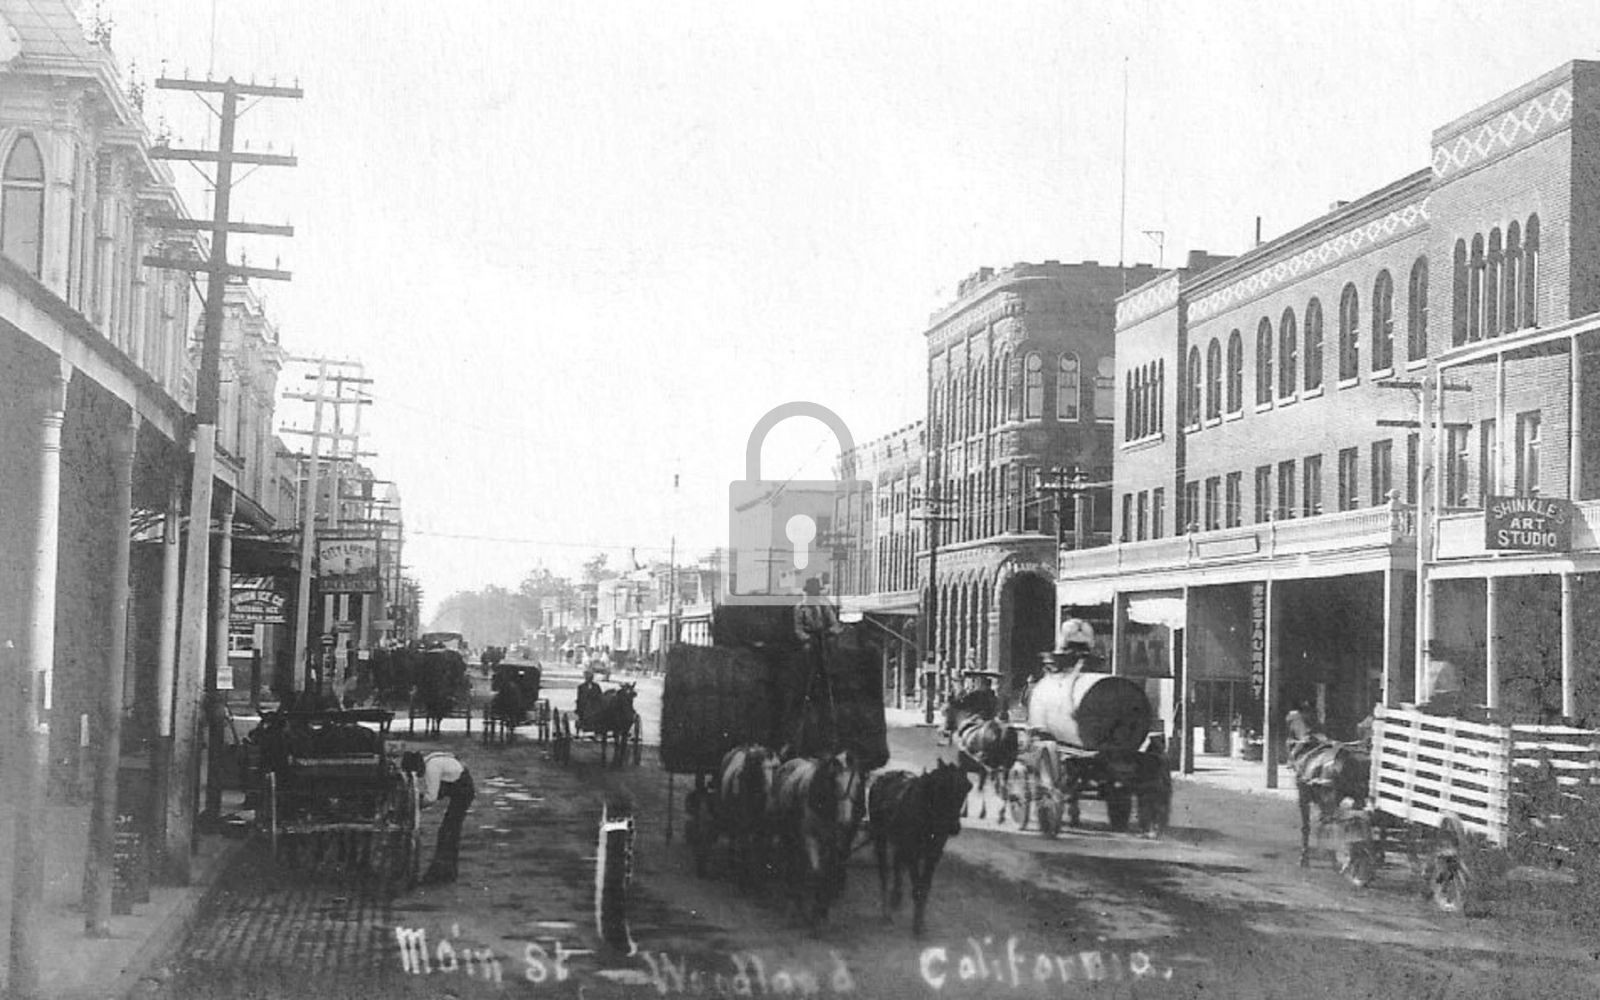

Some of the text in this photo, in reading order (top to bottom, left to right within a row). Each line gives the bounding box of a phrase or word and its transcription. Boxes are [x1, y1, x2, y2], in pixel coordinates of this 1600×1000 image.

[1493, 498, 1564, 523] SHINKLE'S
[1510, 517, 1545, 530] ART
[1498, 529, 1557, 547] STUDIO
[1251, 583, 1264, 700] RESTAURANT
